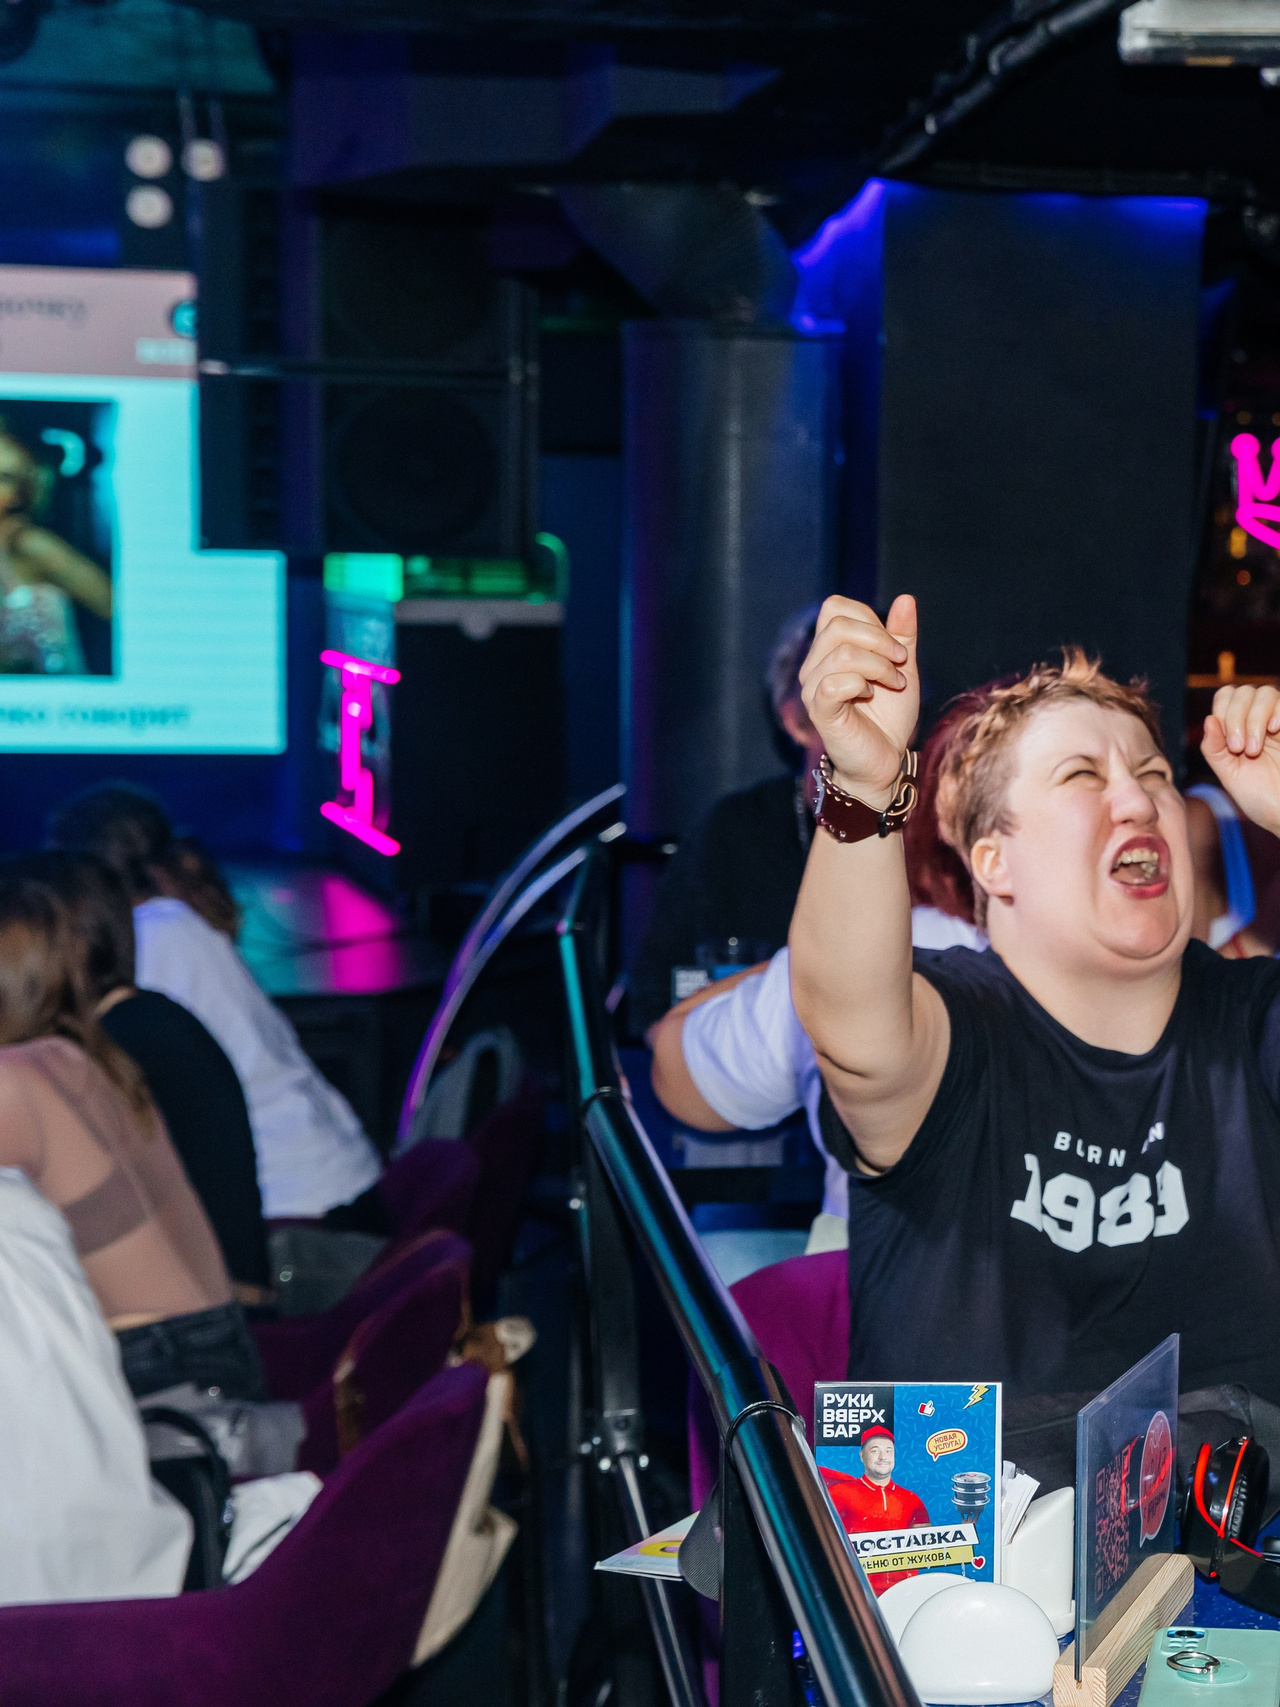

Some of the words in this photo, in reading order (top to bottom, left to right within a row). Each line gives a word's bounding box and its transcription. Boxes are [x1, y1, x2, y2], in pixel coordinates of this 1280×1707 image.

[822, 1393, 874, 1408] РУКИ
[822, 1408, 886, 1423] ВВЕРХ
[822, 1424, 861, 1438] БАР
[933, 1439, 962, 1452] УСЛУГА!
[934, 1432, 958, 1445] НОВАЯ
[891, 1556, 905, 1567] ОТ
[907, 1551, 952, 1565] ЖУКОВА
